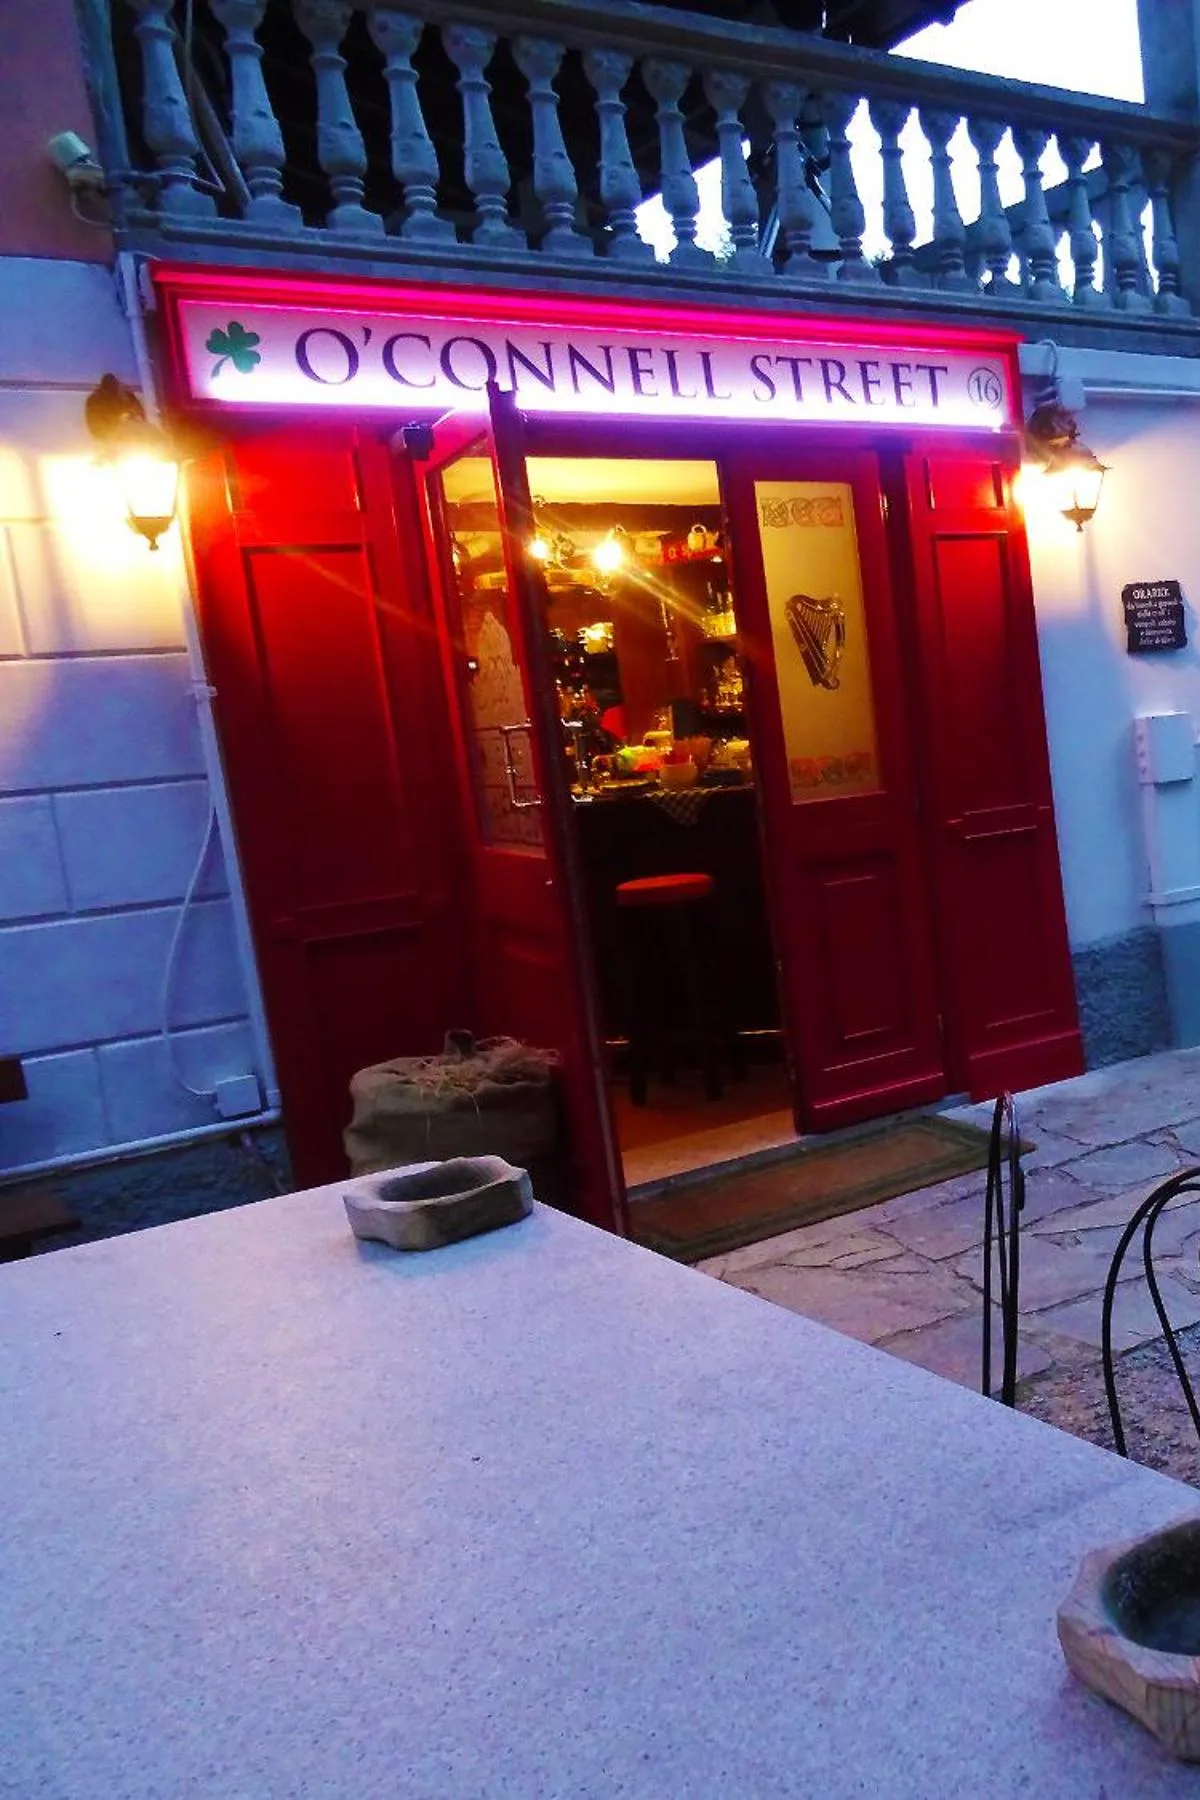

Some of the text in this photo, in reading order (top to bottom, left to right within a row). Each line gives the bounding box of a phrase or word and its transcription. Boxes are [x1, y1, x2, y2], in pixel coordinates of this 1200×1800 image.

[295, 326, 948, 408] O'CONNELL STREET
[971, 372, 1000, 405] 16
